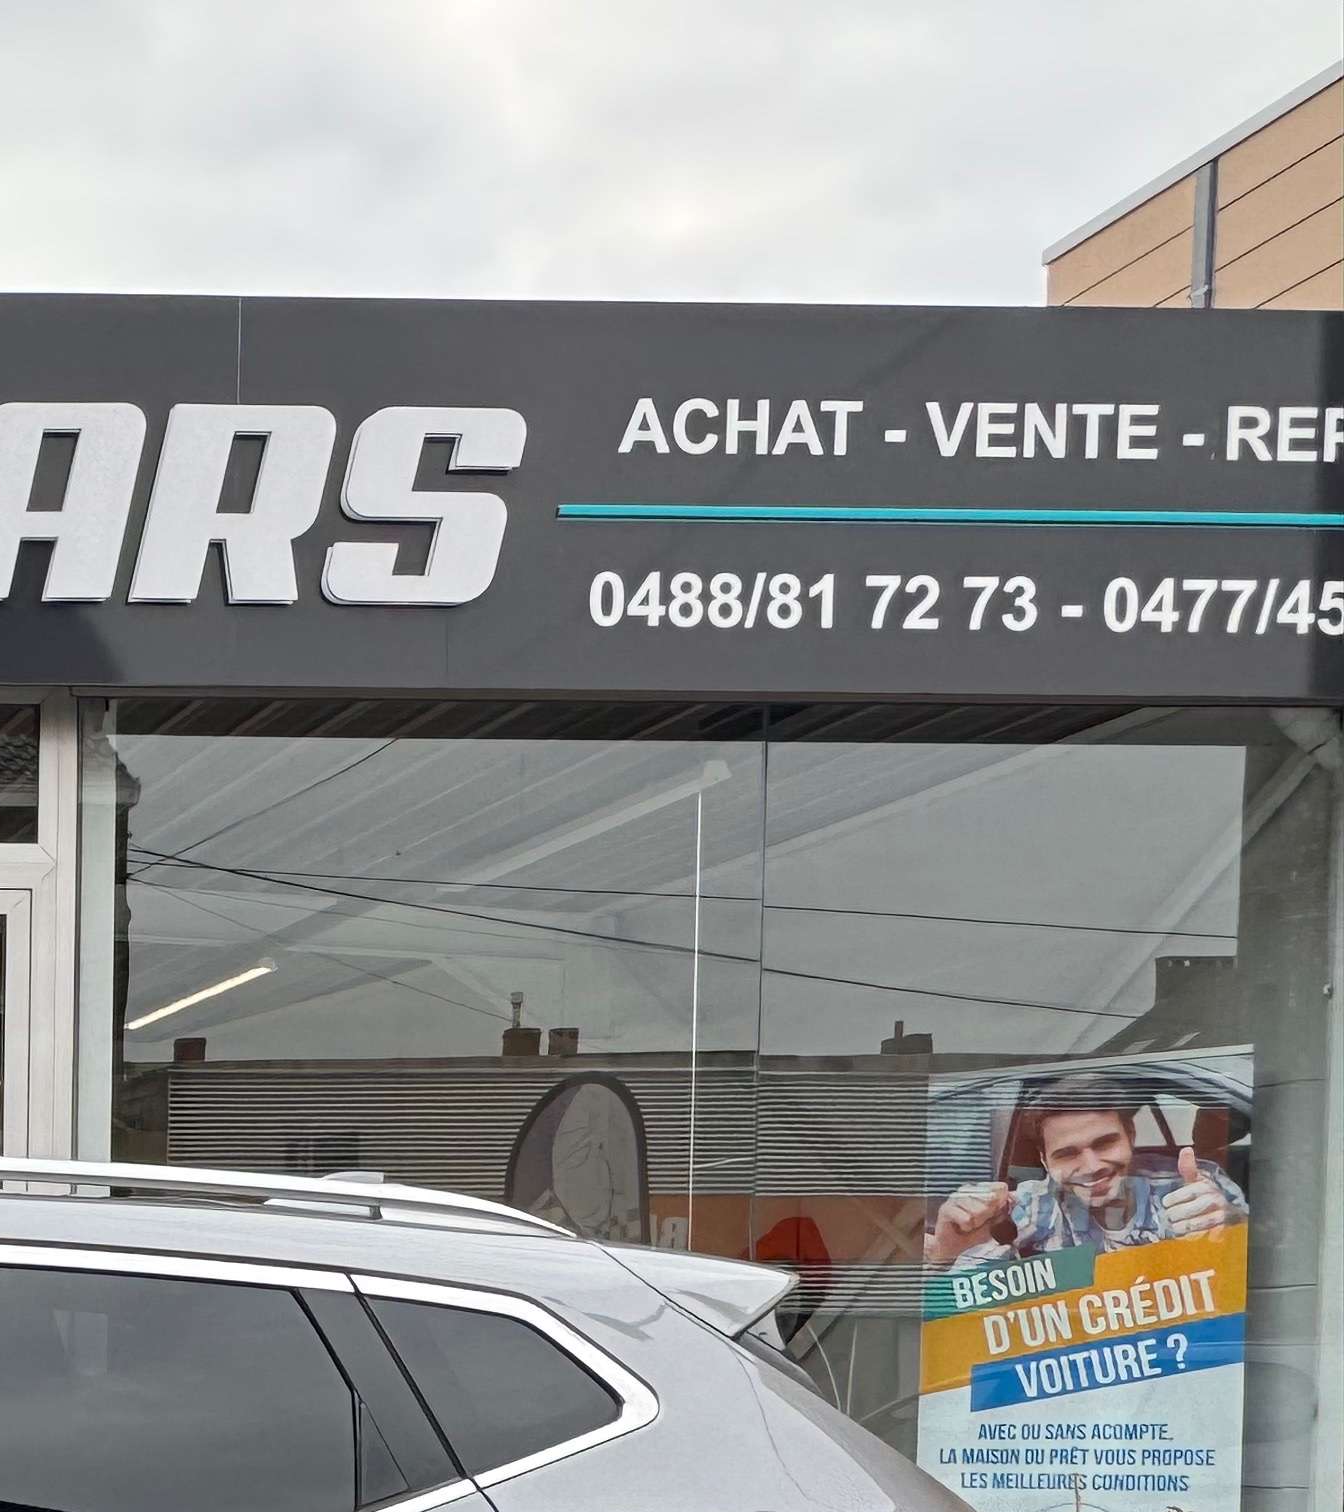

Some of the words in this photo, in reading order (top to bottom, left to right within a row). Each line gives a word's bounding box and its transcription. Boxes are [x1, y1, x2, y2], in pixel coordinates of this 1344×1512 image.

[617, 398, 864, 456] ACHAT
[925, 401, 1161, 460] VENTE
[588, 571, 836, 629] 0488/81
[864, 574, 941, 630] 72
[962, 576, 1038, 631] 73
[1103, 577, 1344, 635] 0477/45
[952, 1258, 1056, 1309] BESOIN
[983, 1300, 1072, 1355] D'UN
[1079, 1269, 1216, 1336] CRÉDIT
[1015, 1337, 1161, 1398] VOITURE
[1166, 1333, 1189, 1370] ?
[939, 1448, 957, 1464] LA
[962, 1448, 1020, 1465] MAISON
[1049, 1446, 1088, 1465] PRÊT
[1094, 1449, 1136, 1466] VOUS
[1141, 1449, 1216, 1466] PROPOSE
[978, 1423, 1016, 1440] AVEC
[1022, 1424, 1040, 1440] OU
[1045, 1424, 1086, 1440] SANS
[961, 1472, 988, 1489] LES
[992, 1472, 1087, 1490] MEILLEURES
[1092, 1474, 1190, 1491] CONDITIONS
